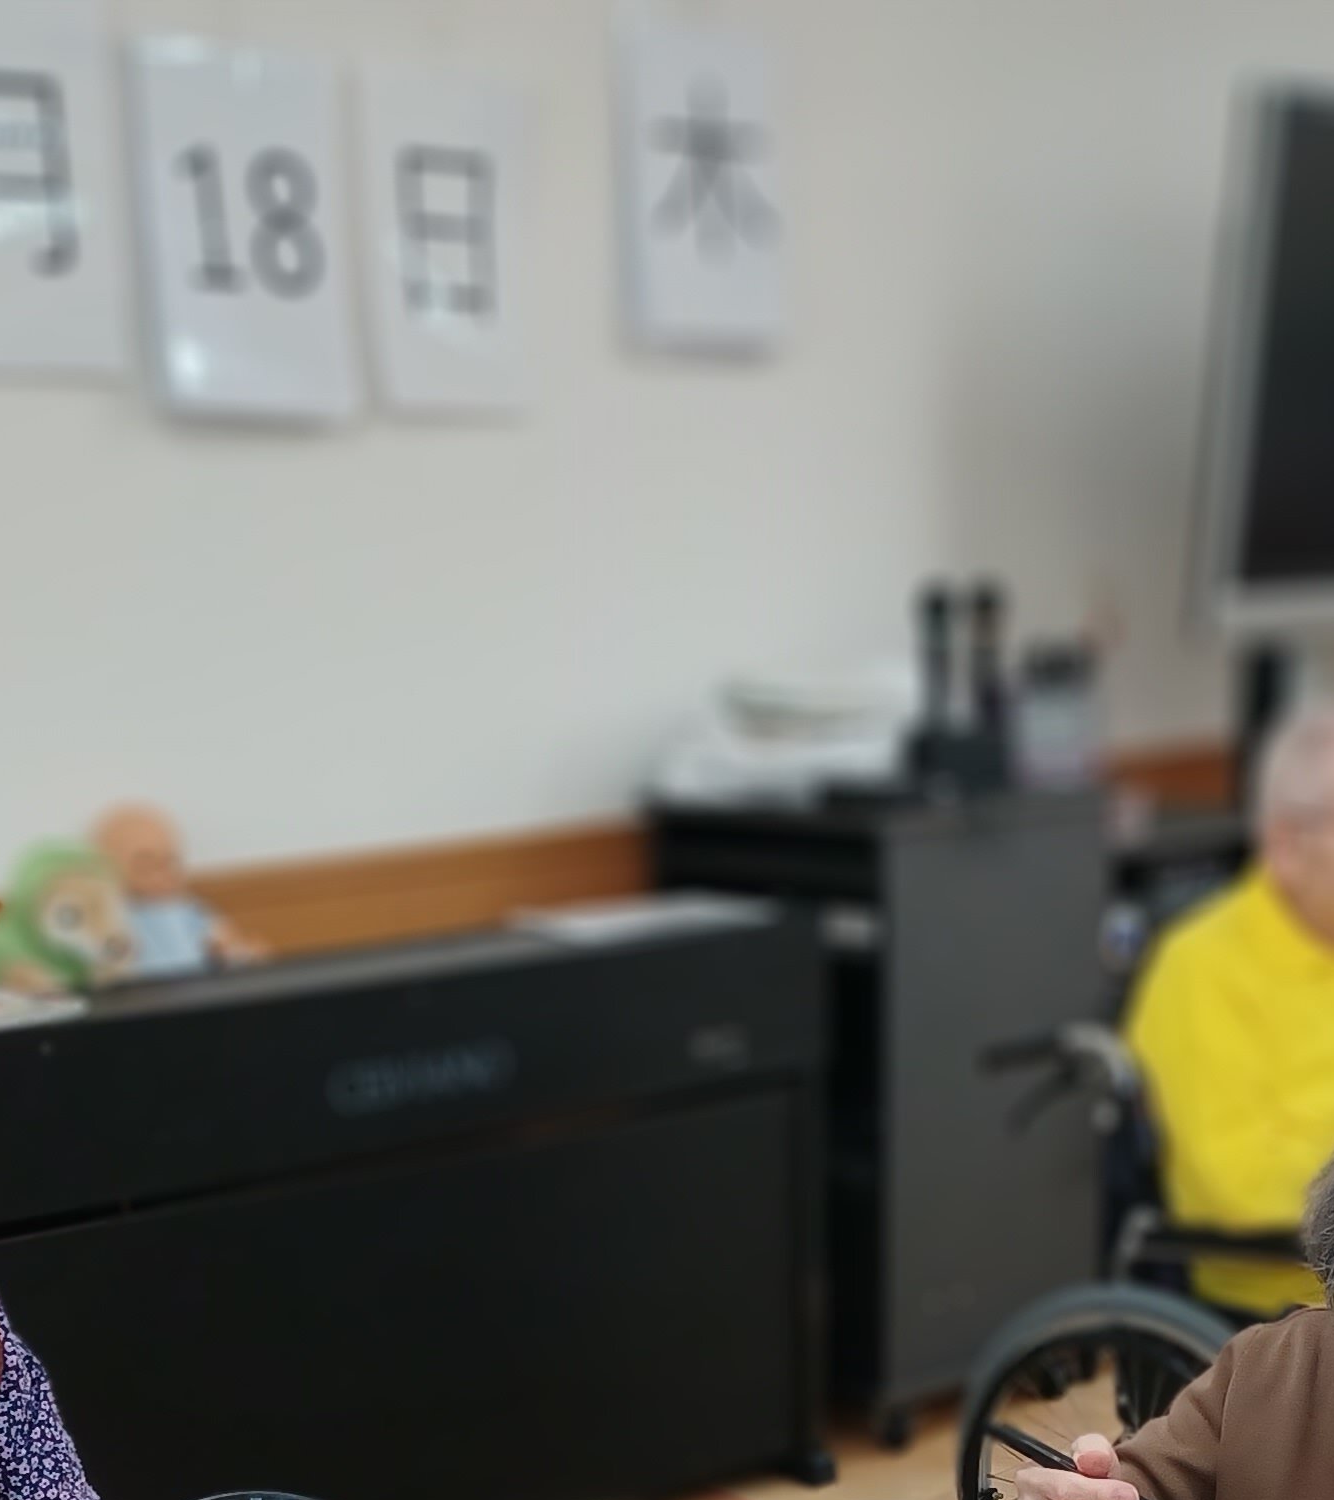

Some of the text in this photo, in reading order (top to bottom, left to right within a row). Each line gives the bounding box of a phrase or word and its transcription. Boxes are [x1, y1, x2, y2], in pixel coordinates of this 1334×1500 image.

[175, 143, 327, 300] 18
[393, 143, 497, 322] 日
[647, 72, 789, 265] 木
